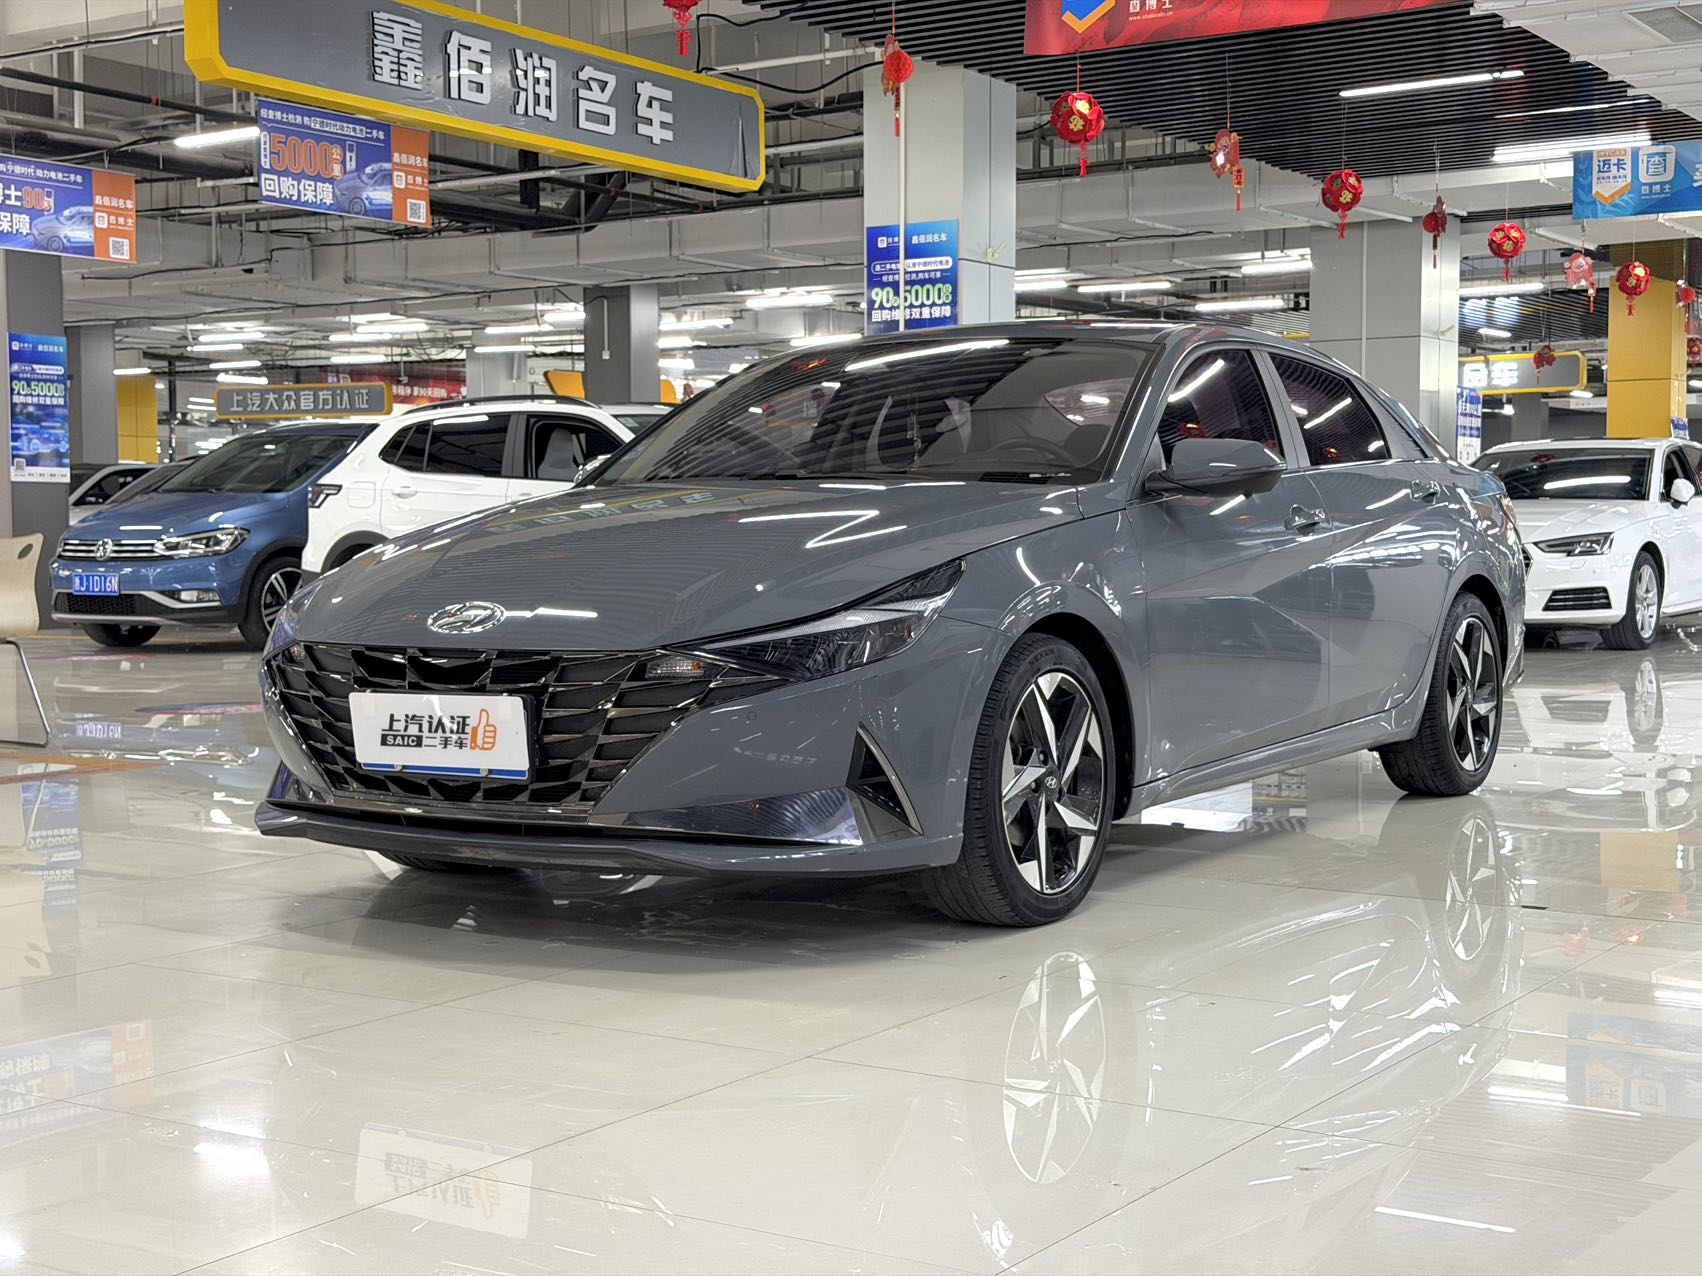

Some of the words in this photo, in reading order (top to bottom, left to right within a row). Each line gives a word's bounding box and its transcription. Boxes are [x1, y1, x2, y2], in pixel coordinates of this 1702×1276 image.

[370, 10, 675, 145] 鑫佰润名车
[1597, 158, 1627, 174] 迈卡
[261, 172, 334, 206] 回购保障
[229, 388, 370, 413] 上汽大众官方认证
[381, 712, 471, 735] 上汽认证
[386, 735, 418, 746] SAIC
[423, 736, 470, 750] 二手车
